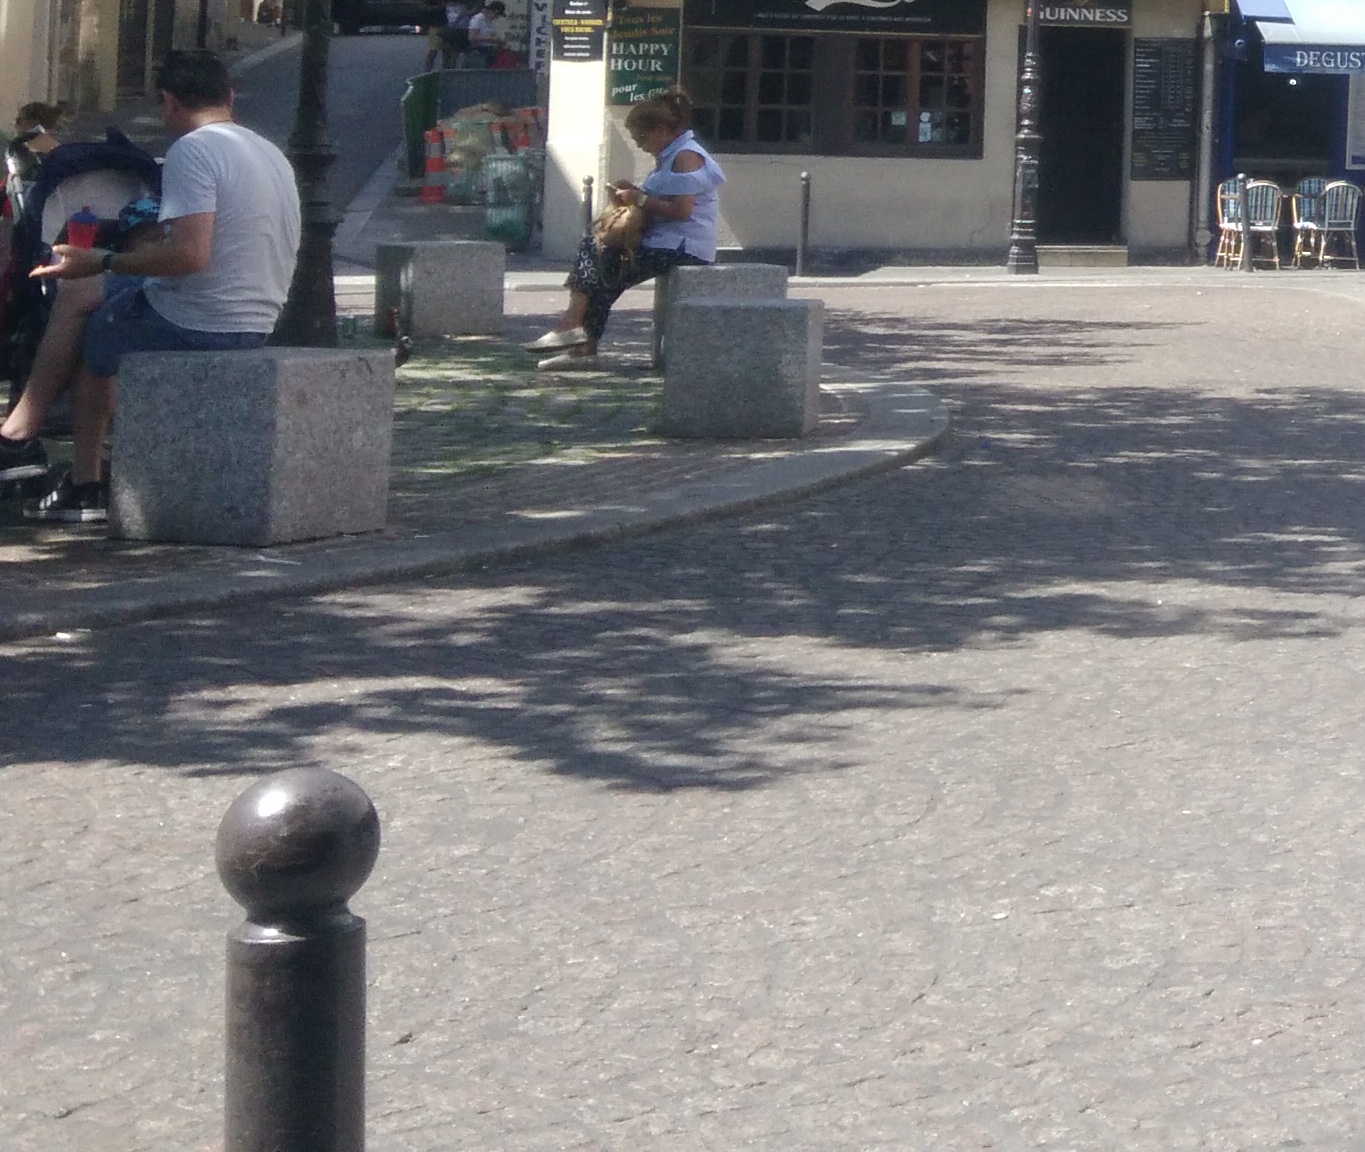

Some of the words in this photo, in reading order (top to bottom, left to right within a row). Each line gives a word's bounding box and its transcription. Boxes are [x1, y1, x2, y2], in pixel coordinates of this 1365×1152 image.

[1038, 5, 1128, 22] UINNESS
[612, 43, 672, 56] HAPPY
[610, 58, 663, 72] HOUR
[612, 84, 638, 97] pour
[630, 92, 645, 102] les
